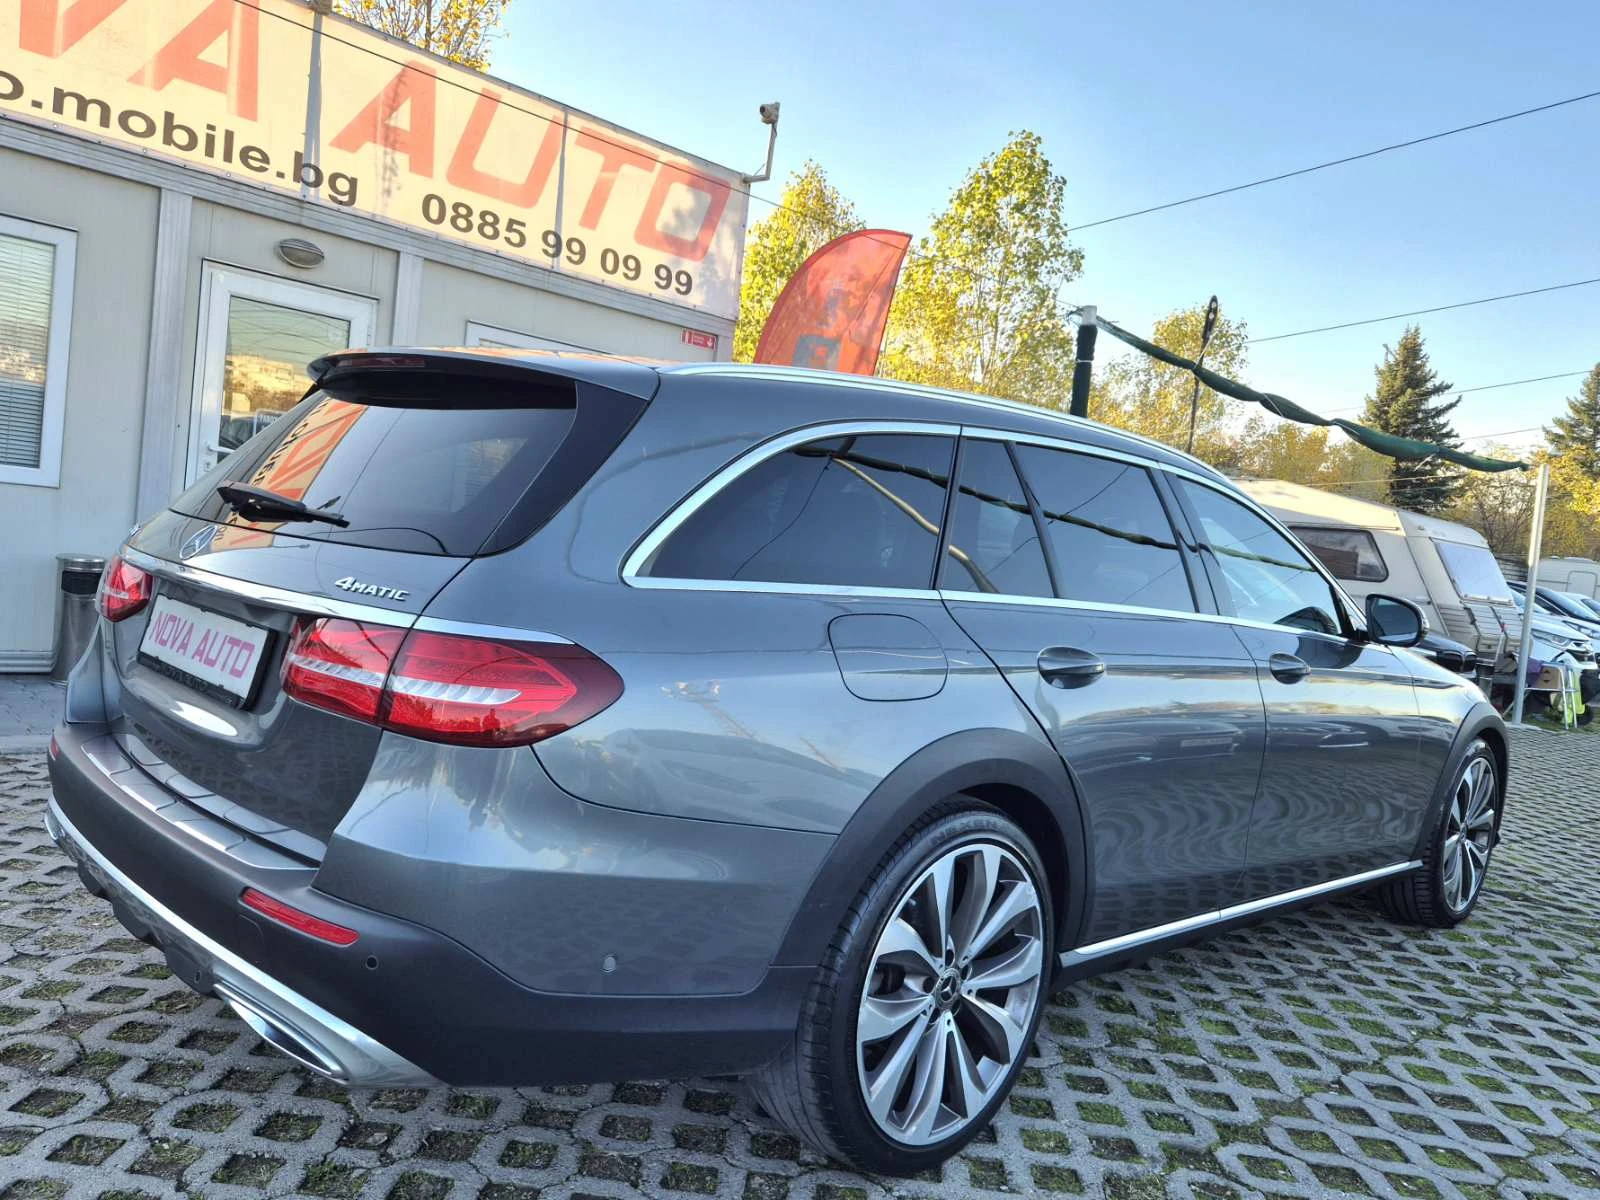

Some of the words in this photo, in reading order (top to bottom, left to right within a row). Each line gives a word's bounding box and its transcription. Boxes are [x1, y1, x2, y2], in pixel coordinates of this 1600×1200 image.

[329, 59, 731, 262] AUTO
[422, 193, 526, 248] 0885
[541, 229, 586, 266] 99
[600, 248, 651, 281] 09
[654, 263, 693, 296] 99
[334, 576, 409, 602] 4MATIC
[149, 611, 195, 657] NOVA
[192, 628, 255, 679] AUTO
